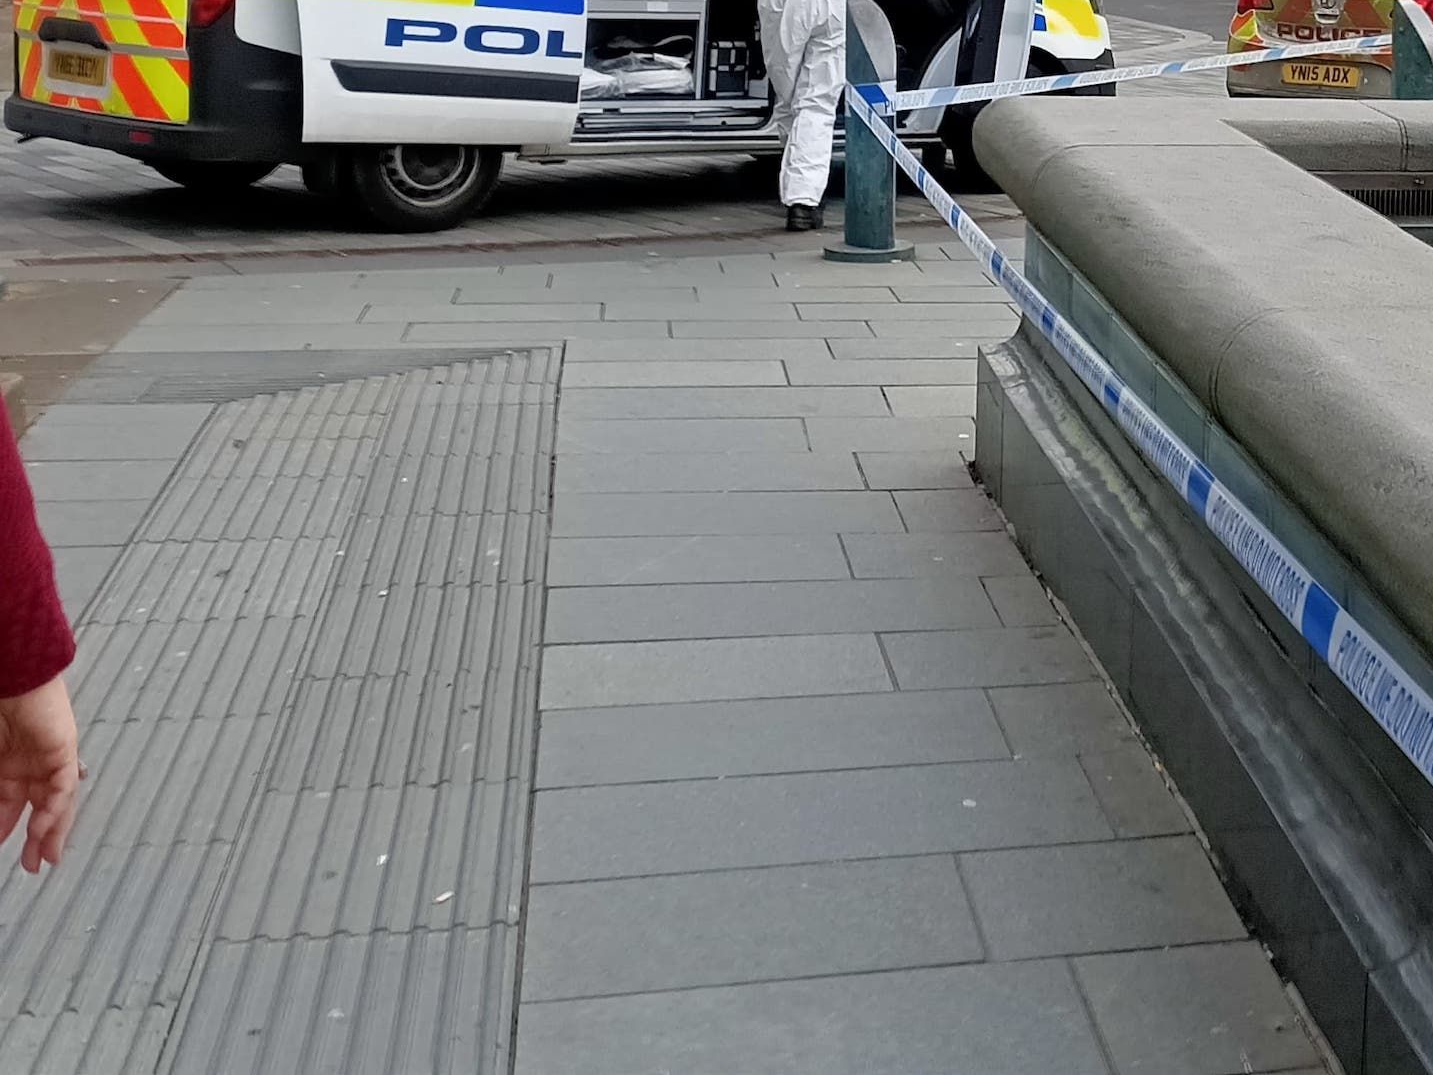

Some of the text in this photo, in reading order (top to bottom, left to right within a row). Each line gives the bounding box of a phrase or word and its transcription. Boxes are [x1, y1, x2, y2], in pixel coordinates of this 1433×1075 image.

[384, 18, 583, 59] POL
[1277, 22, 1382, 42] POLICE
[1290, 65, 1351, 84] YN15 ADX
[1335, 630, 1382, 700] POLICE
[1371, 667, 1398, 725] LINE
